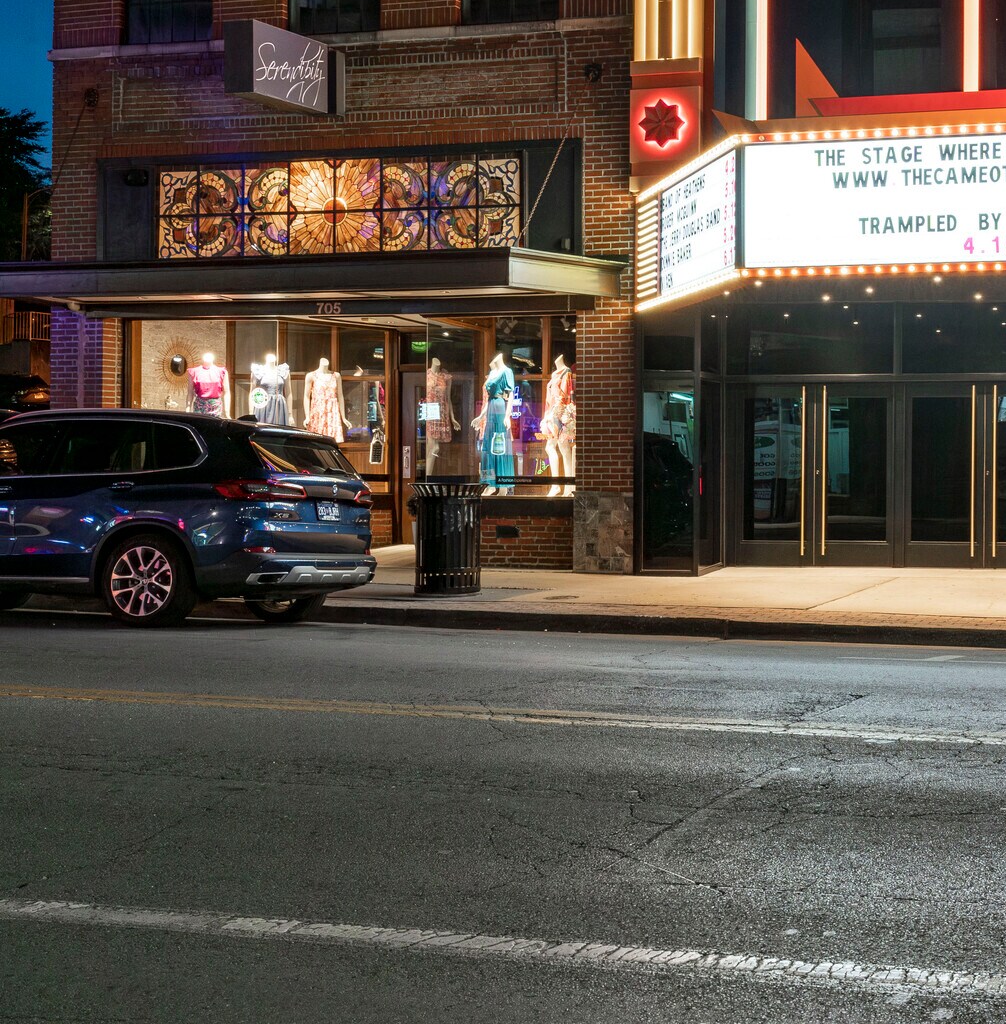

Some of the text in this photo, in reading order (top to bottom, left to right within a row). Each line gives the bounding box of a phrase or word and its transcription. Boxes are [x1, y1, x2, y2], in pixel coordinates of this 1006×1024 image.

[256, 42, 325, 106] Serendipity
[815, 149, 846, 166] THE
[863, 146, 923, 164] STAGE
[940, 142, 1001, 161] WHERE
[858, 213, 957, 235] TRAMPLED
[978, 211, 1000, 231] BY
[317, 302, 341, 315] 705
